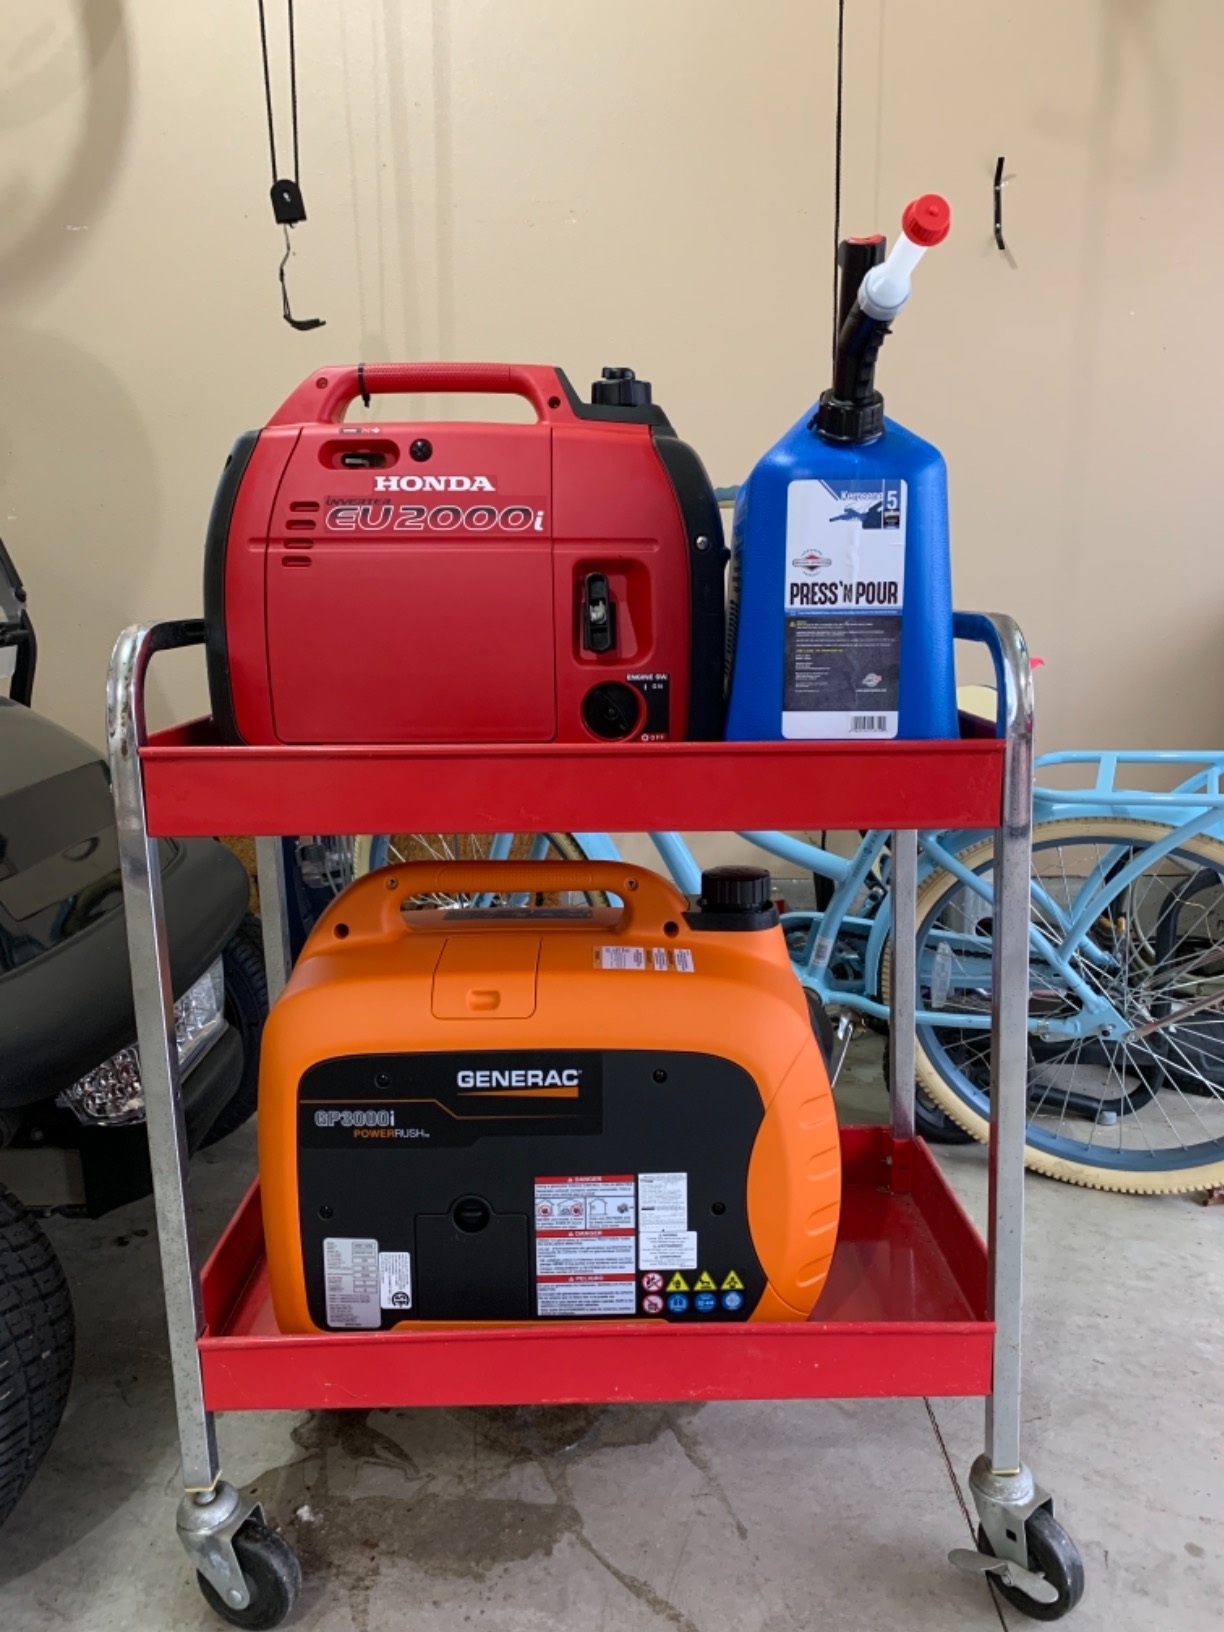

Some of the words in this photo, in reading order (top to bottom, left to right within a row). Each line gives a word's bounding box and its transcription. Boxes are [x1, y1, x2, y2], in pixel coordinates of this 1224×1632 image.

[374, 475, 496, 492] HONDA
[886, 490, 898, 510] 5
[325, 505, 544, 531] EU2000i
[790, 582, 839, 606] PRESS
[855, 580, 898, 605] POUR
[626, 673, 654, 682] ENGINE
[456, 1069, 580, 1088] GENERAC
[314, 1109, 395, 1127] GP3000i
